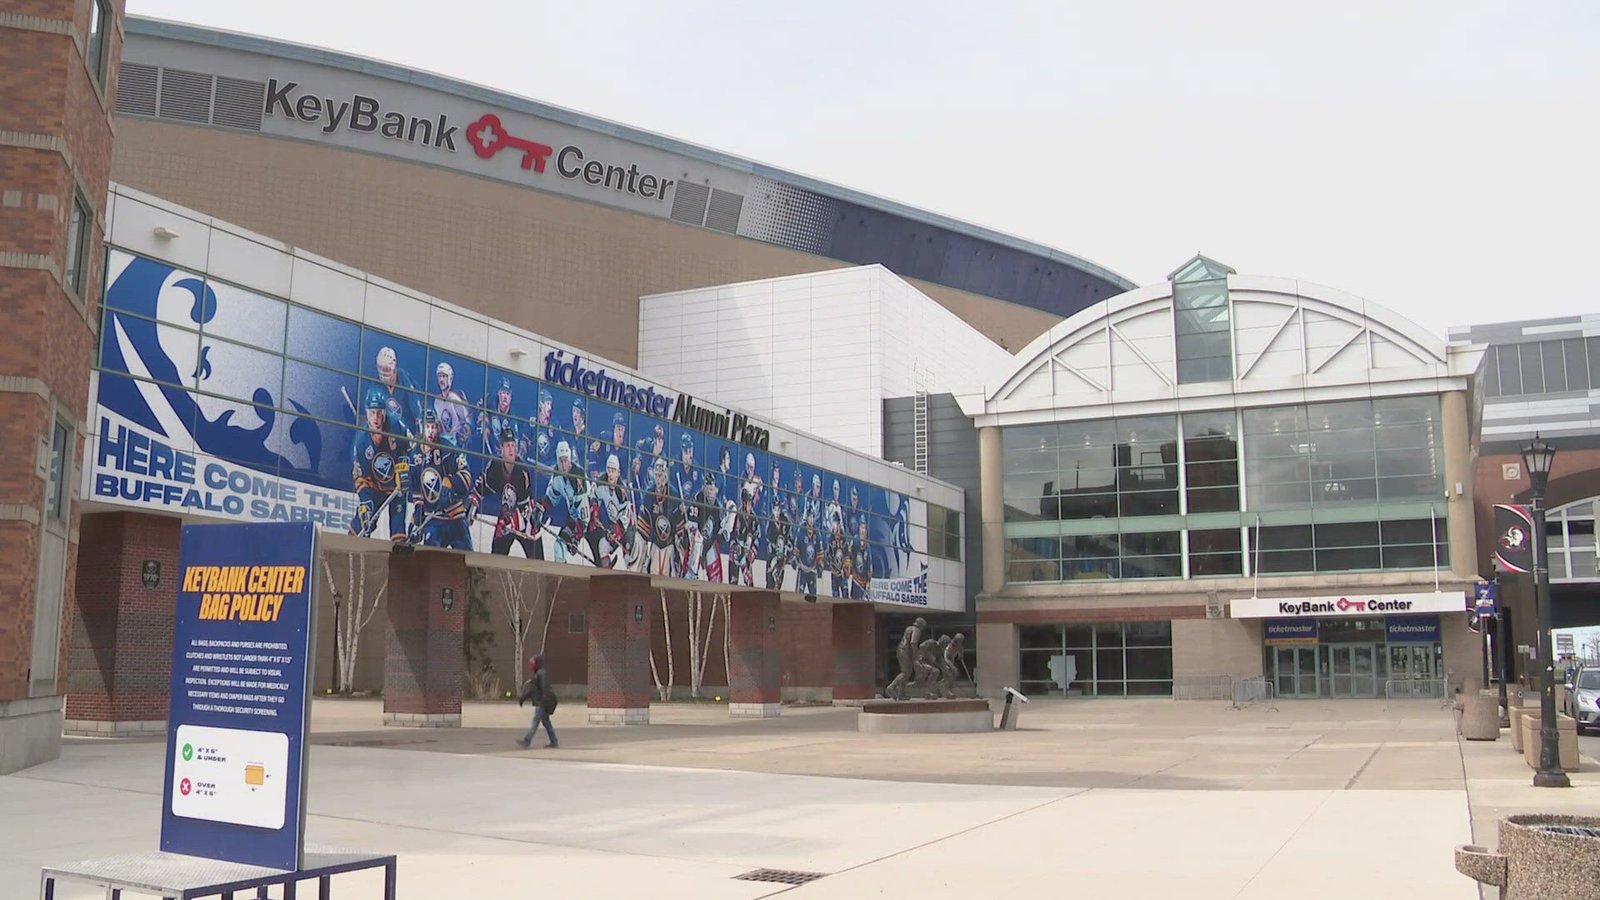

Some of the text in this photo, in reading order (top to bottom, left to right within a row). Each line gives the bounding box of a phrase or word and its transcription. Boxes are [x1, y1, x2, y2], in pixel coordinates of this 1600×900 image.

[264, 78, 674, 202] KeyBank Center
[544, 350, 770, 451] ticketmaster Alumni Plaza
[98, 416, 356, 511] HERE COME THE
[95, 473, 353, 530] BUFFALO SABRES
[182, 566, 306, 593] KEYBANK CENTER
[890, 580, 912, 592] COME
[914, 572, 927, 594] THE
[198, 594, 284, 622] BAG POLICY
[901, 593, 928, 606] SABRES
[1278, 600, 1412, 614] KeyBank Center
[1268, 624, 1312, 634] ticketmaster
[1390, 624, 1436, 632] ticketmaster
